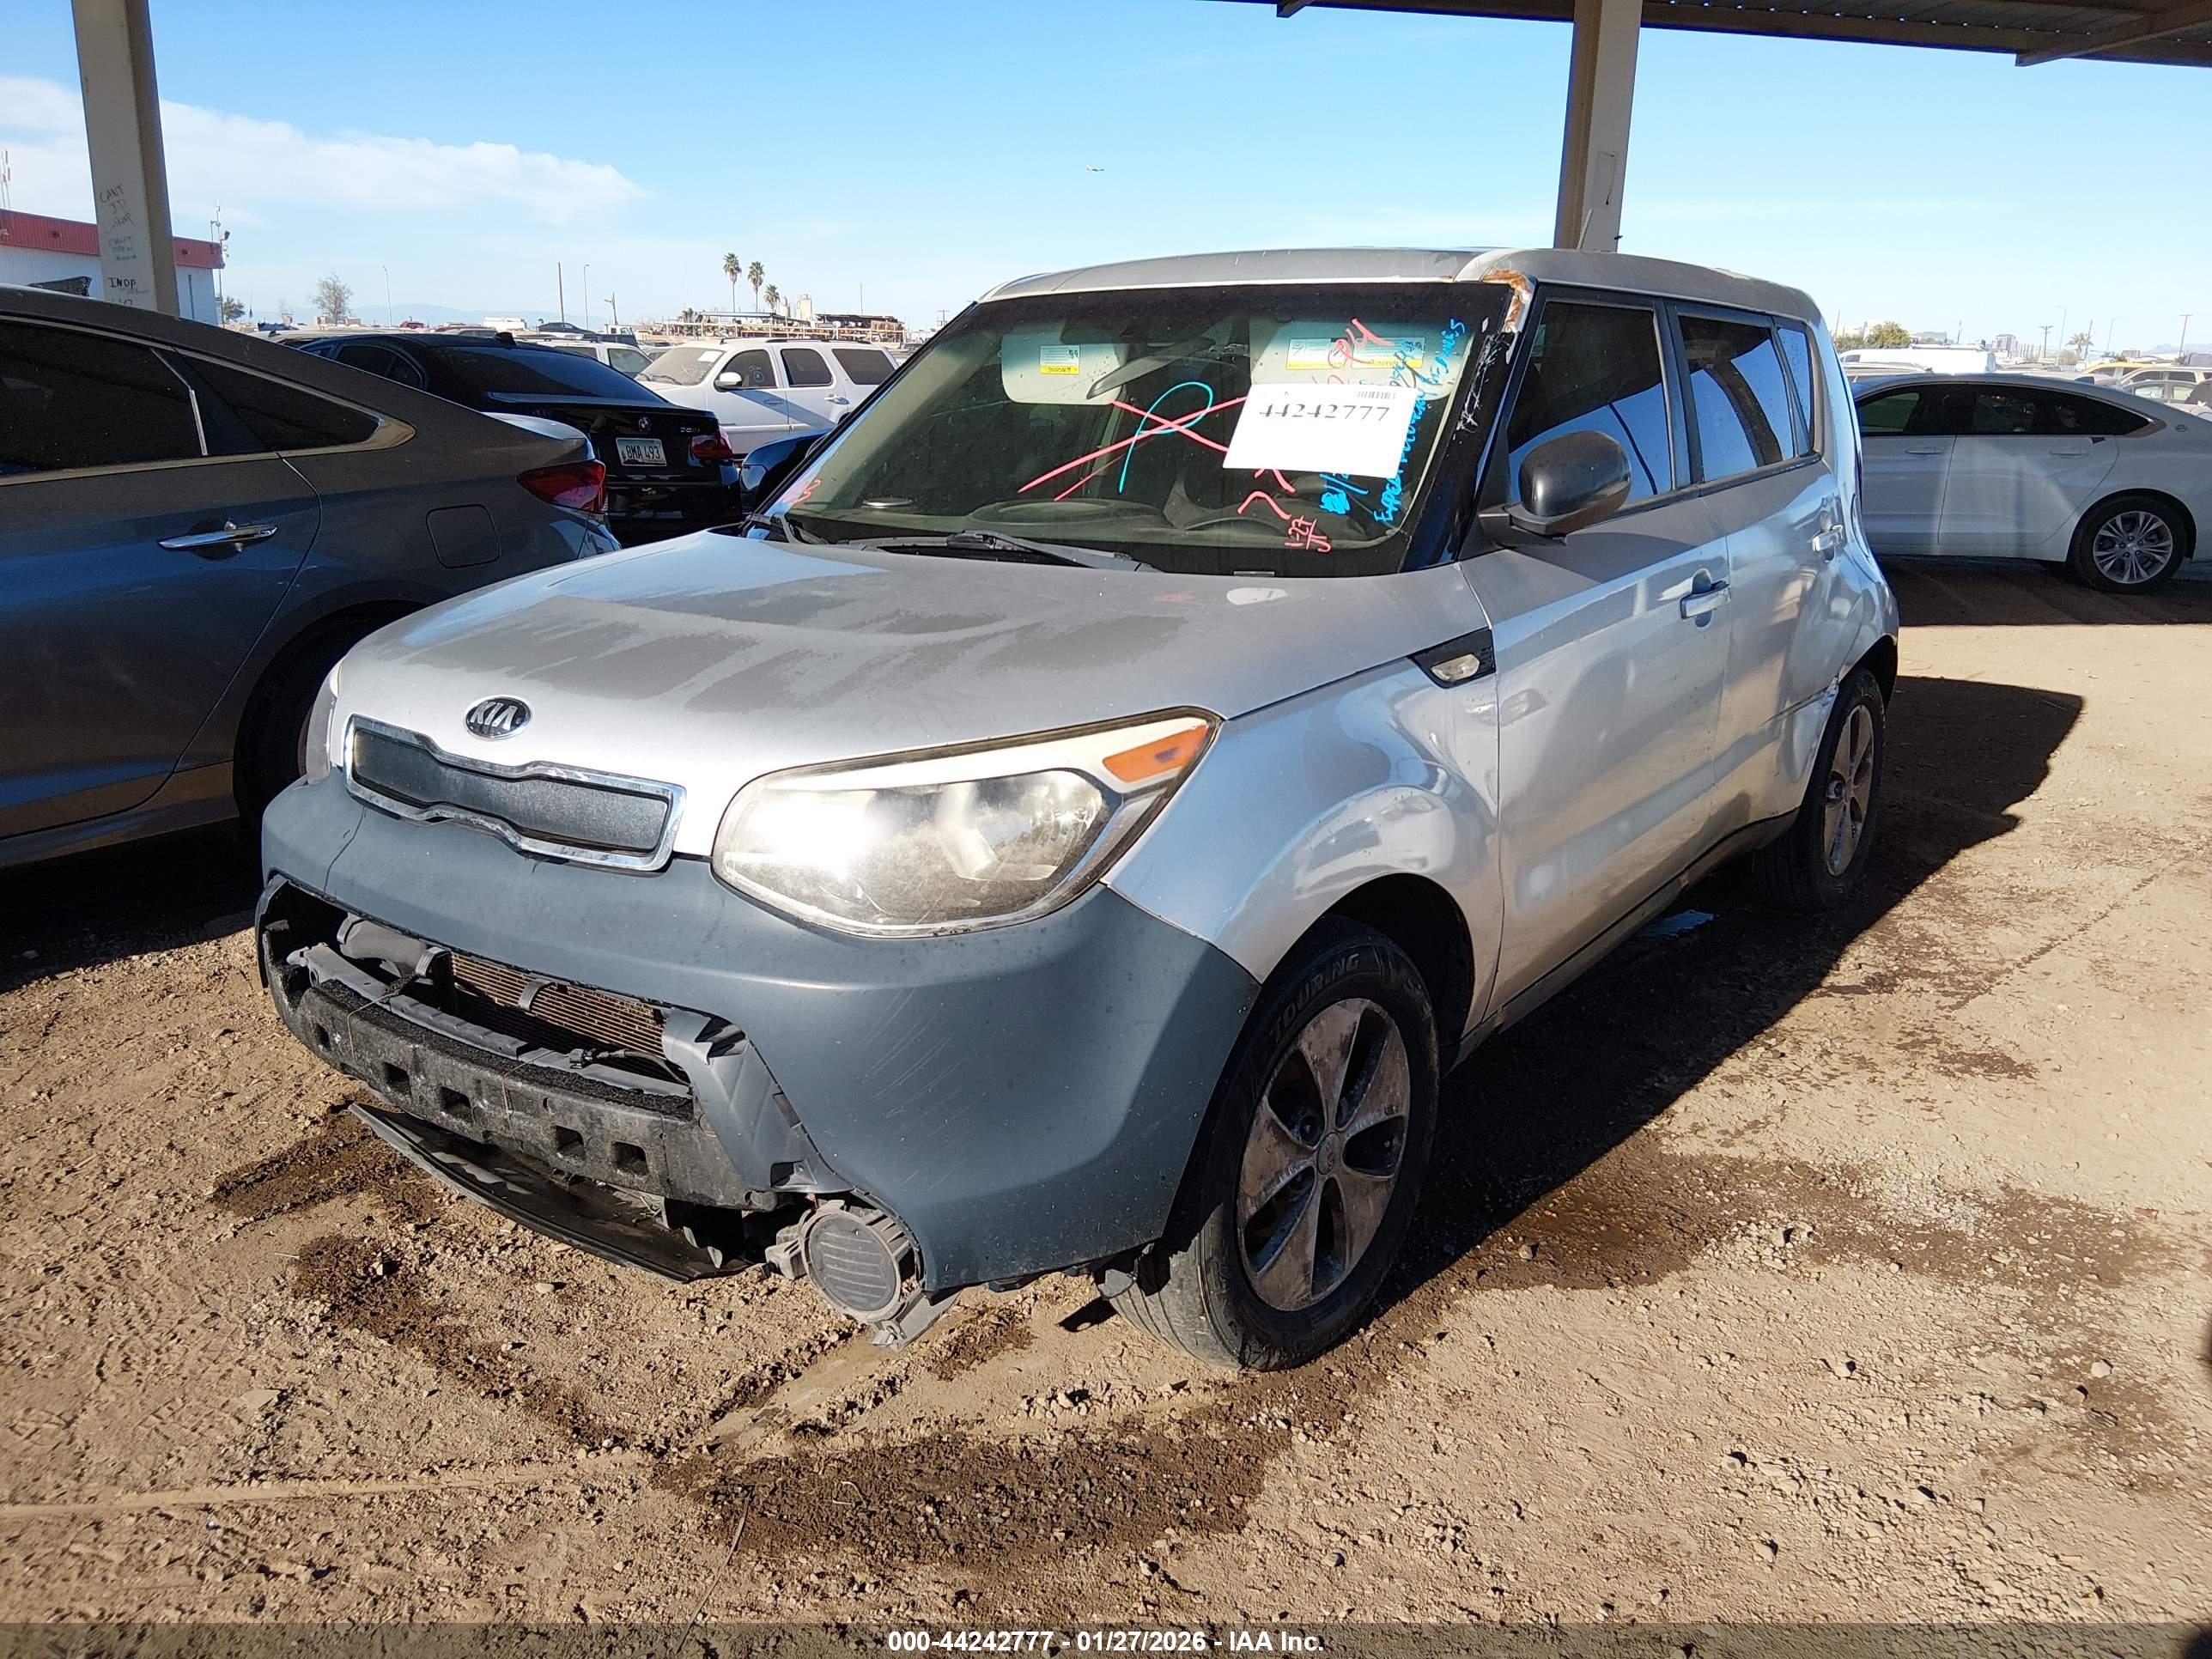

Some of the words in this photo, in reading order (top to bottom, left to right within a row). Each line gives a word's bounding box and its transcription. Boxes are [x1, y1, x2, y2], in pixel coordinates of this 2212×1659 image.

[108, 276, 137, 289] INOP
[1259, 404, 1390, 422] 44242777
[644, 445, 660, 459] 493
[470, 701, 519, 731] KIA
